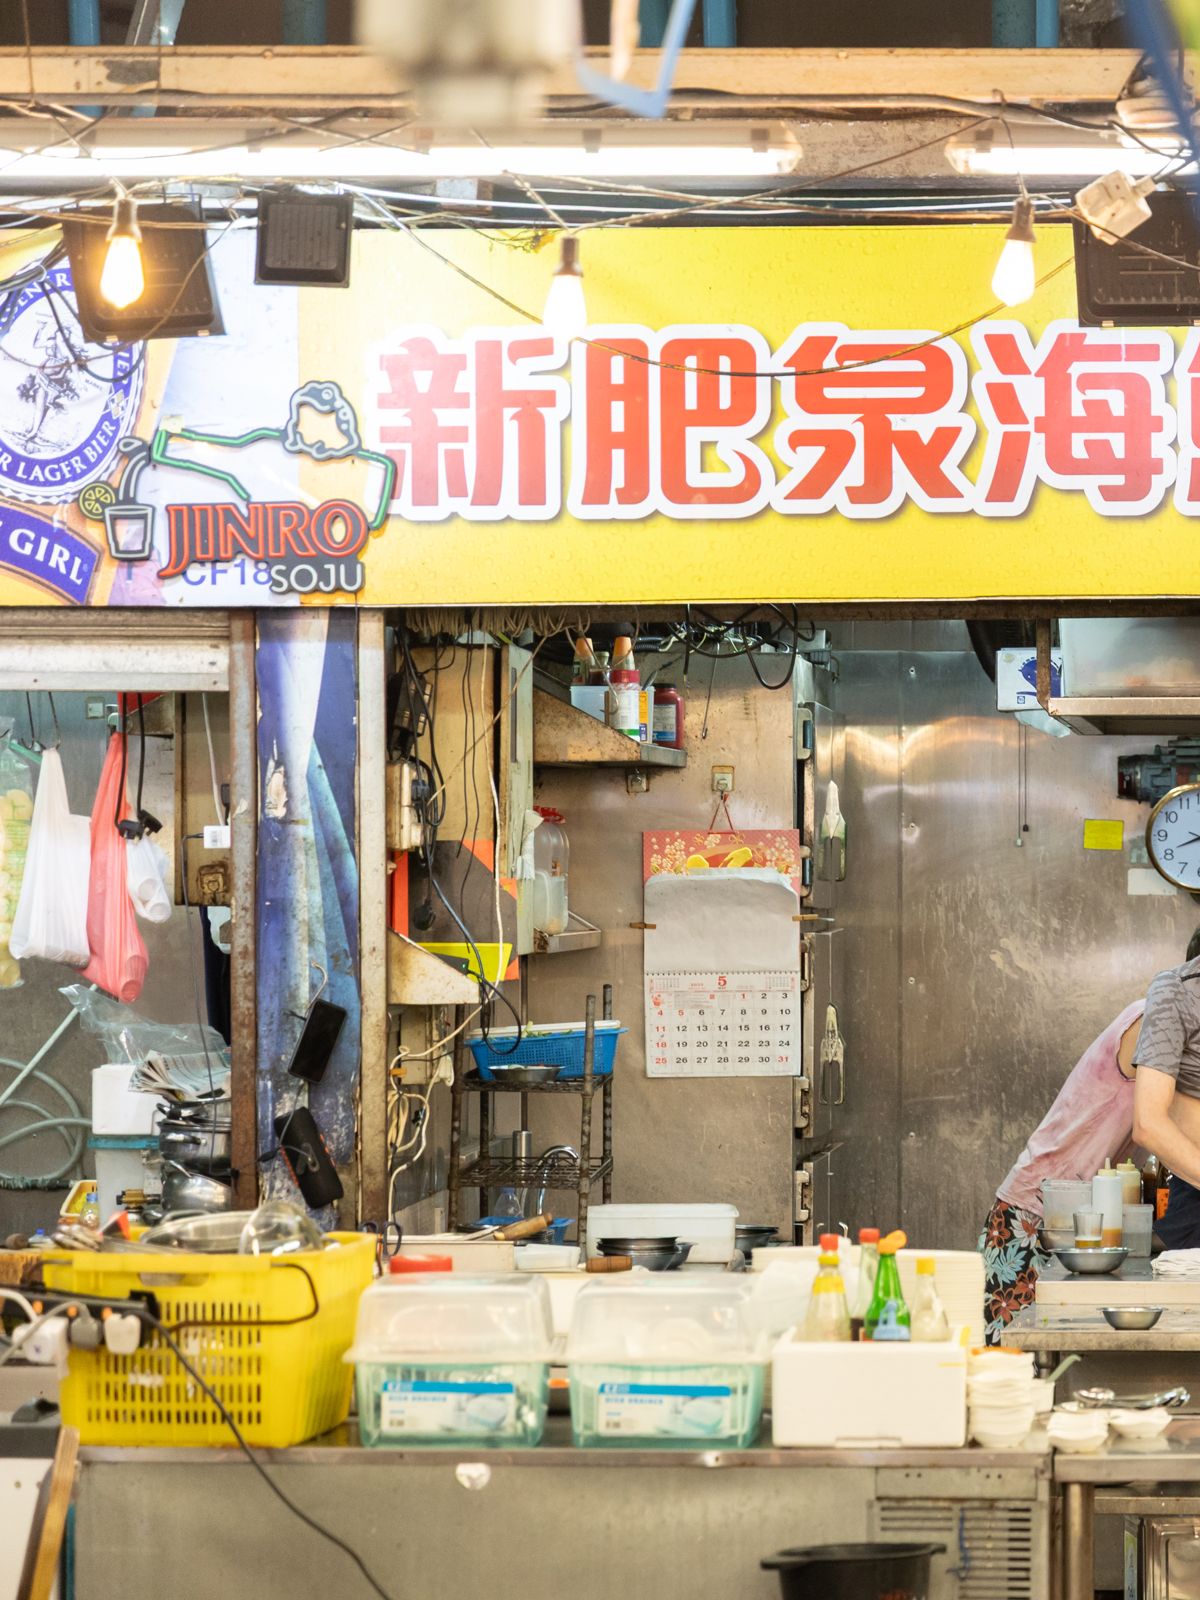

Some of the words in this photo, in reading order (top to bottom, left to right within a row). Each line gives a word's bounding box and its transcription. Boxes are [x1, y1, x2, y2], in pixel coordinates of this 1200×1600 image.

[83, 420, 117, 463] BIER
[157, 500, 368, 578] JINRO
[8, 528, 84, 586] GIRL
[182, 560, 272, 586] CF18
[270, 564, 362, 592] SOJU
[1179, 798, 1190, 809] 11
[1165, 811, 1178, 823] 10
[1157, 829, 1168, 841] 9
[1163, 848, 1174, 860] 8
[1178, 861, 1188, 874] 7
[718, 975, 727, 987] 5
[760, 1008, 768, 1016] 9
[697, 1024, 708, 1032] 13
[718, 1024, 729, 1032] 14
[738, 1024, 750, 1032] 15
[696, 1040, 709, 1048] 20
[716, 1040, 728, 1048] 21
[737, 1040, 750, 1048] 22
[696, 1056, 708, 1064] 27
[717, 1056, 729, 1064] 28
